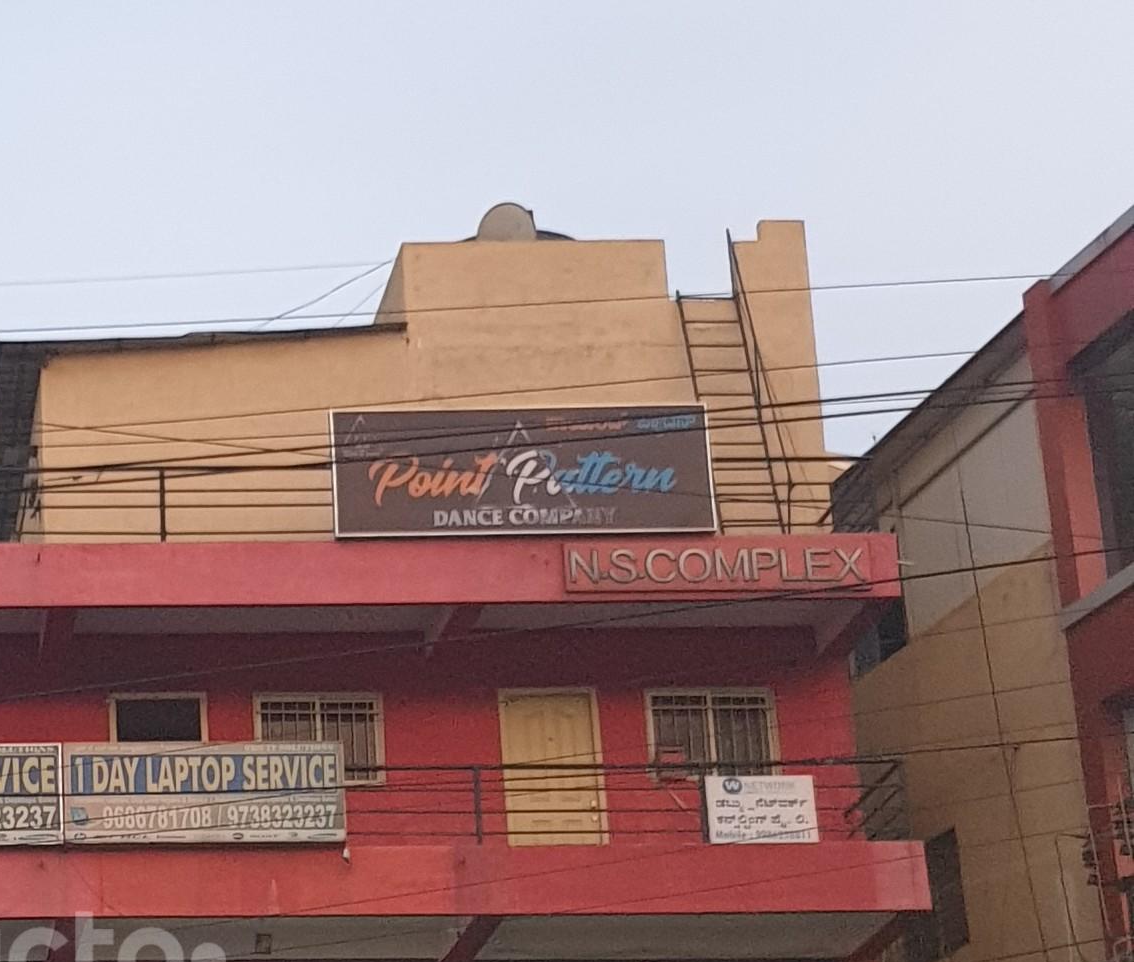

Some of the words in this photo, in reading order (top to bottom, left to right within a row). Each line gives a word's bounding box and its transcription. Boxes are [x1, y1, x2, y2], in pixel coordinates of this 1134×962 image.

[369, 450, 497, 506] Point
[433, 508, 503, 527] DANCE
[508, 506, 616, 526] COMPANY
[74, 757, 85, 794] 1
[92, 756, 139, 793] DAY
[146, 756, 235, 793] LAPTOP
[242, 754, 336, 792] SERVICE
